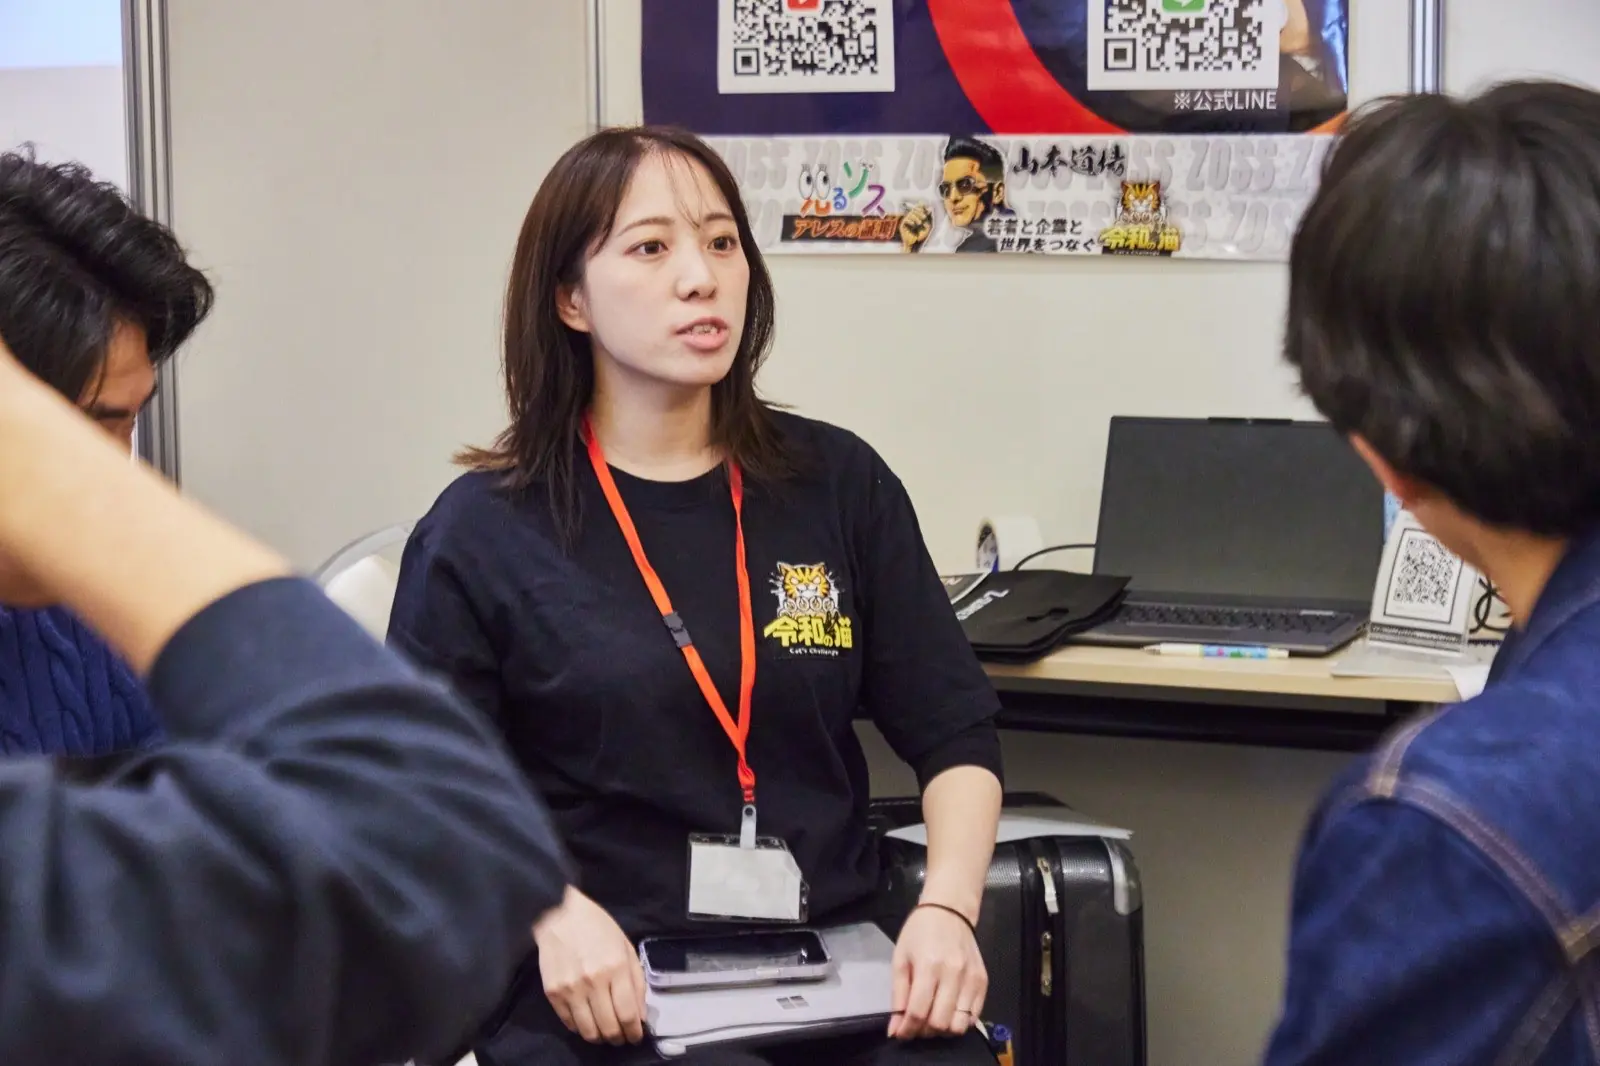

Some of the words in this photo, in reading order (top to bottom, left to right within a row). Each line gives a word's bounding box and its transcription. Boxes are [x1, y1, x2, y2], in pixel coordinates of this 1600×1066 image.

[1174, 90, 1277, 112] ※公式LINE
[986, 218, 1083, 236] 若者と企業と
[1000, 236, 1096, 252] 世界をつなぐ
